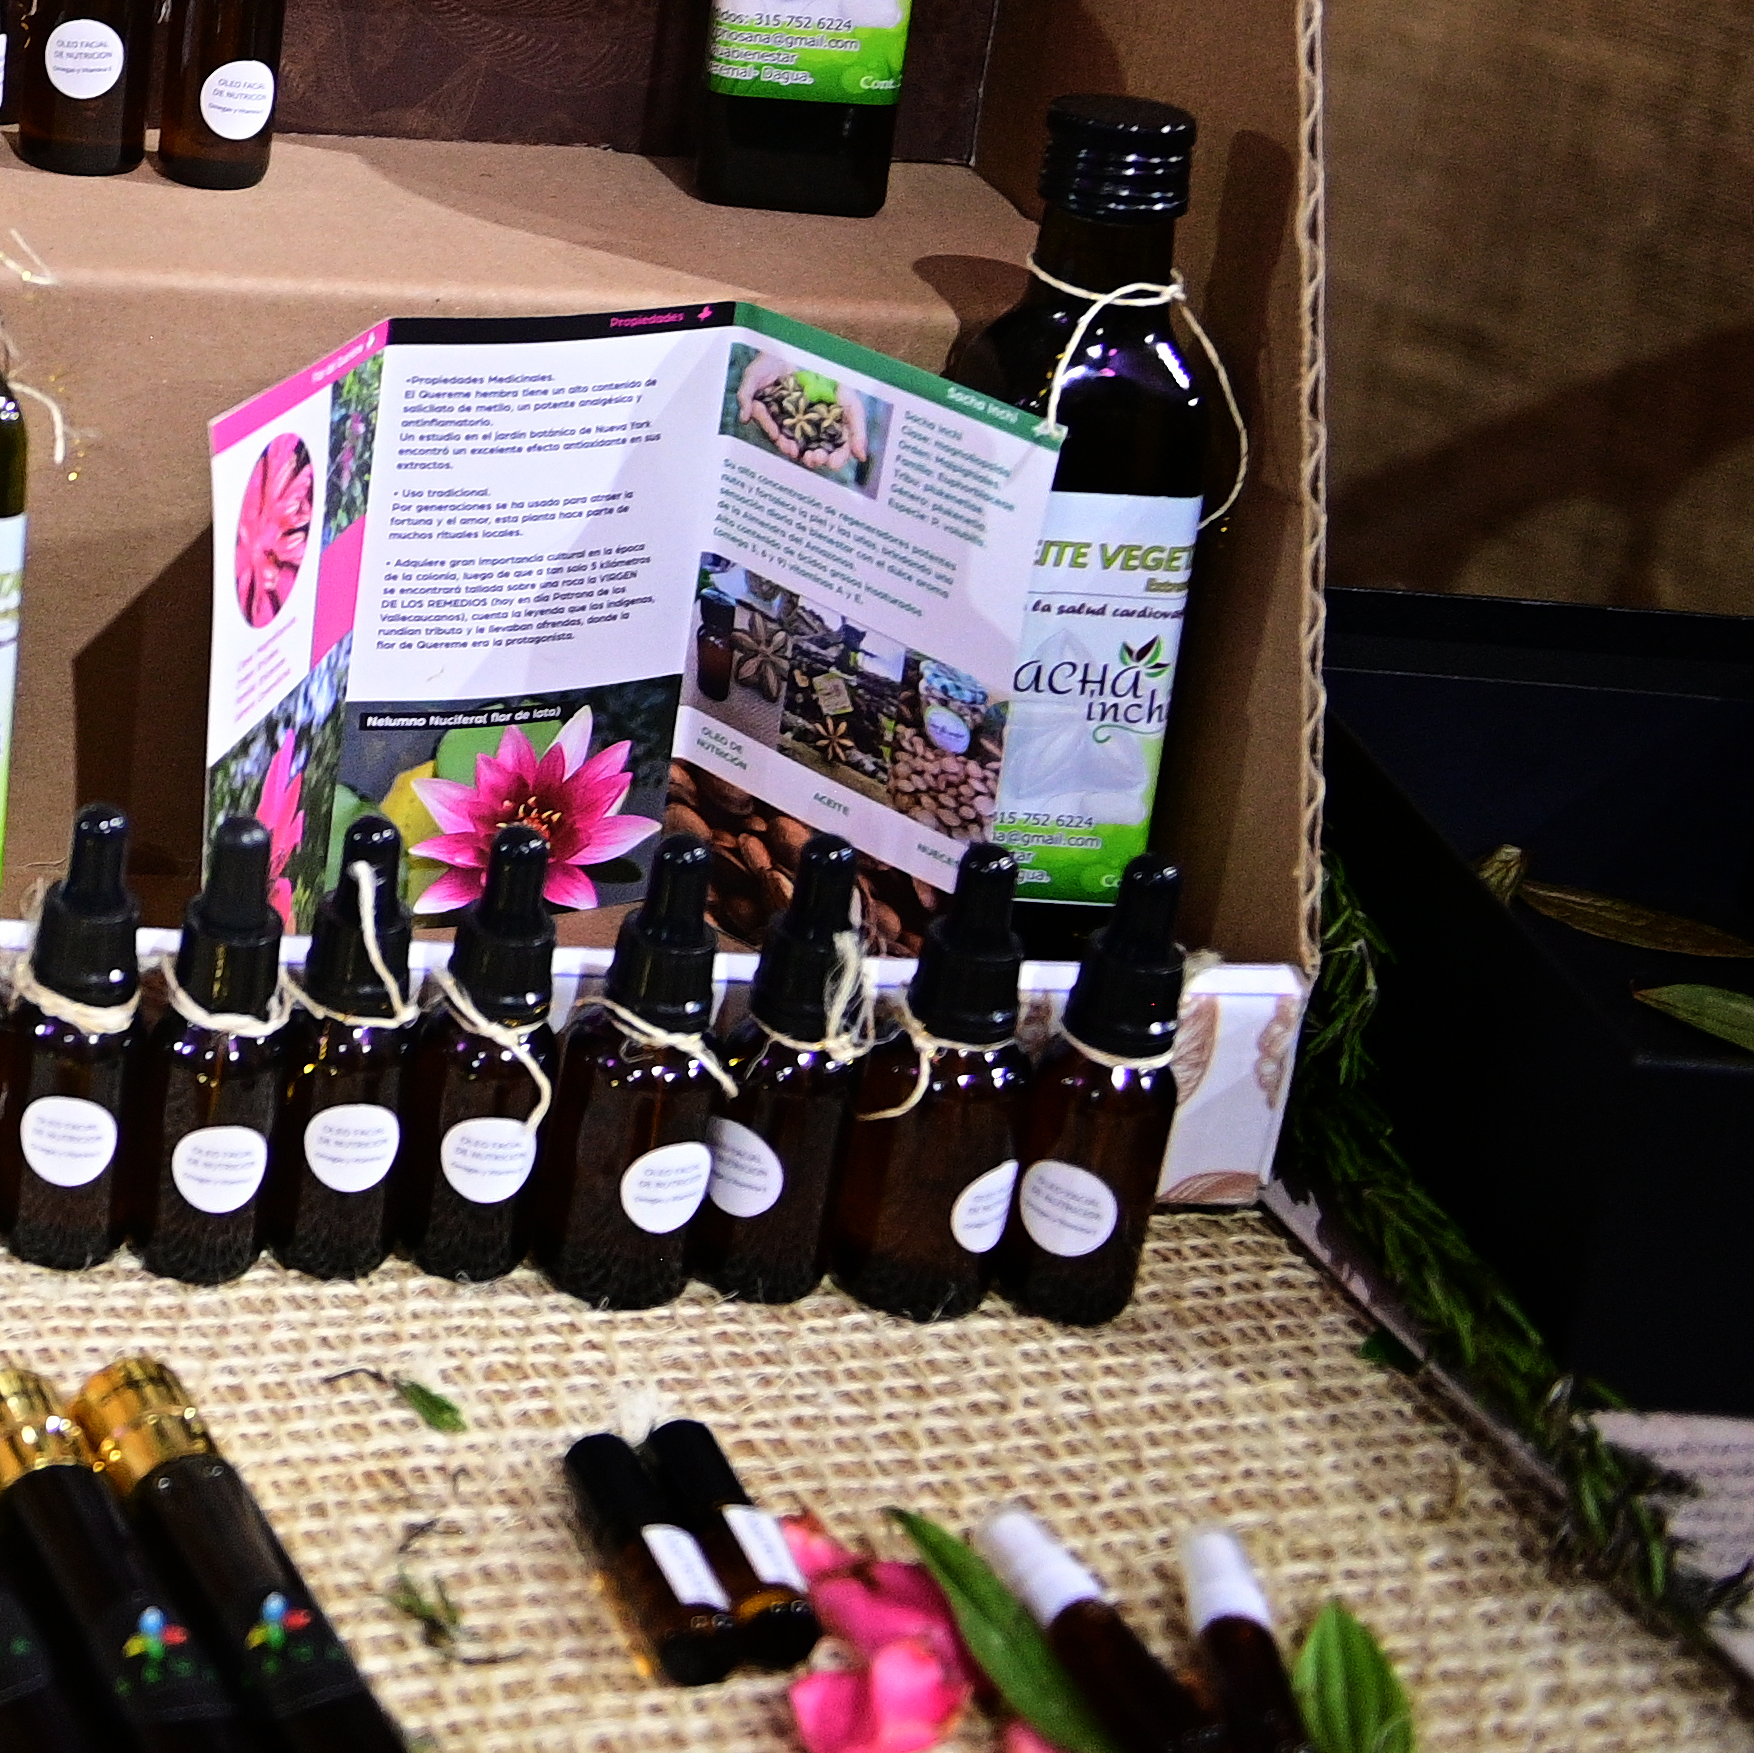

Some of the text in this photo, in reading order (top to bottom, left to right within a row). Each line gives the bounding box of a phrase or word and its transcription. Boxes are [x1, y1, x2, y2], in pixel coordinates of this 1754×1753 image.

[755, 13, 852, 31] 315 752 6224
[1034, 540, 1092, 568] ITE
[1032, 599, 1051, 612] la
[1057, 603, 1107, 616] salud
[1086, 689, 1169, 725] inch
[1022, 812, 1051, 826] 752
[1056, 814, 1093, 827] 6224
